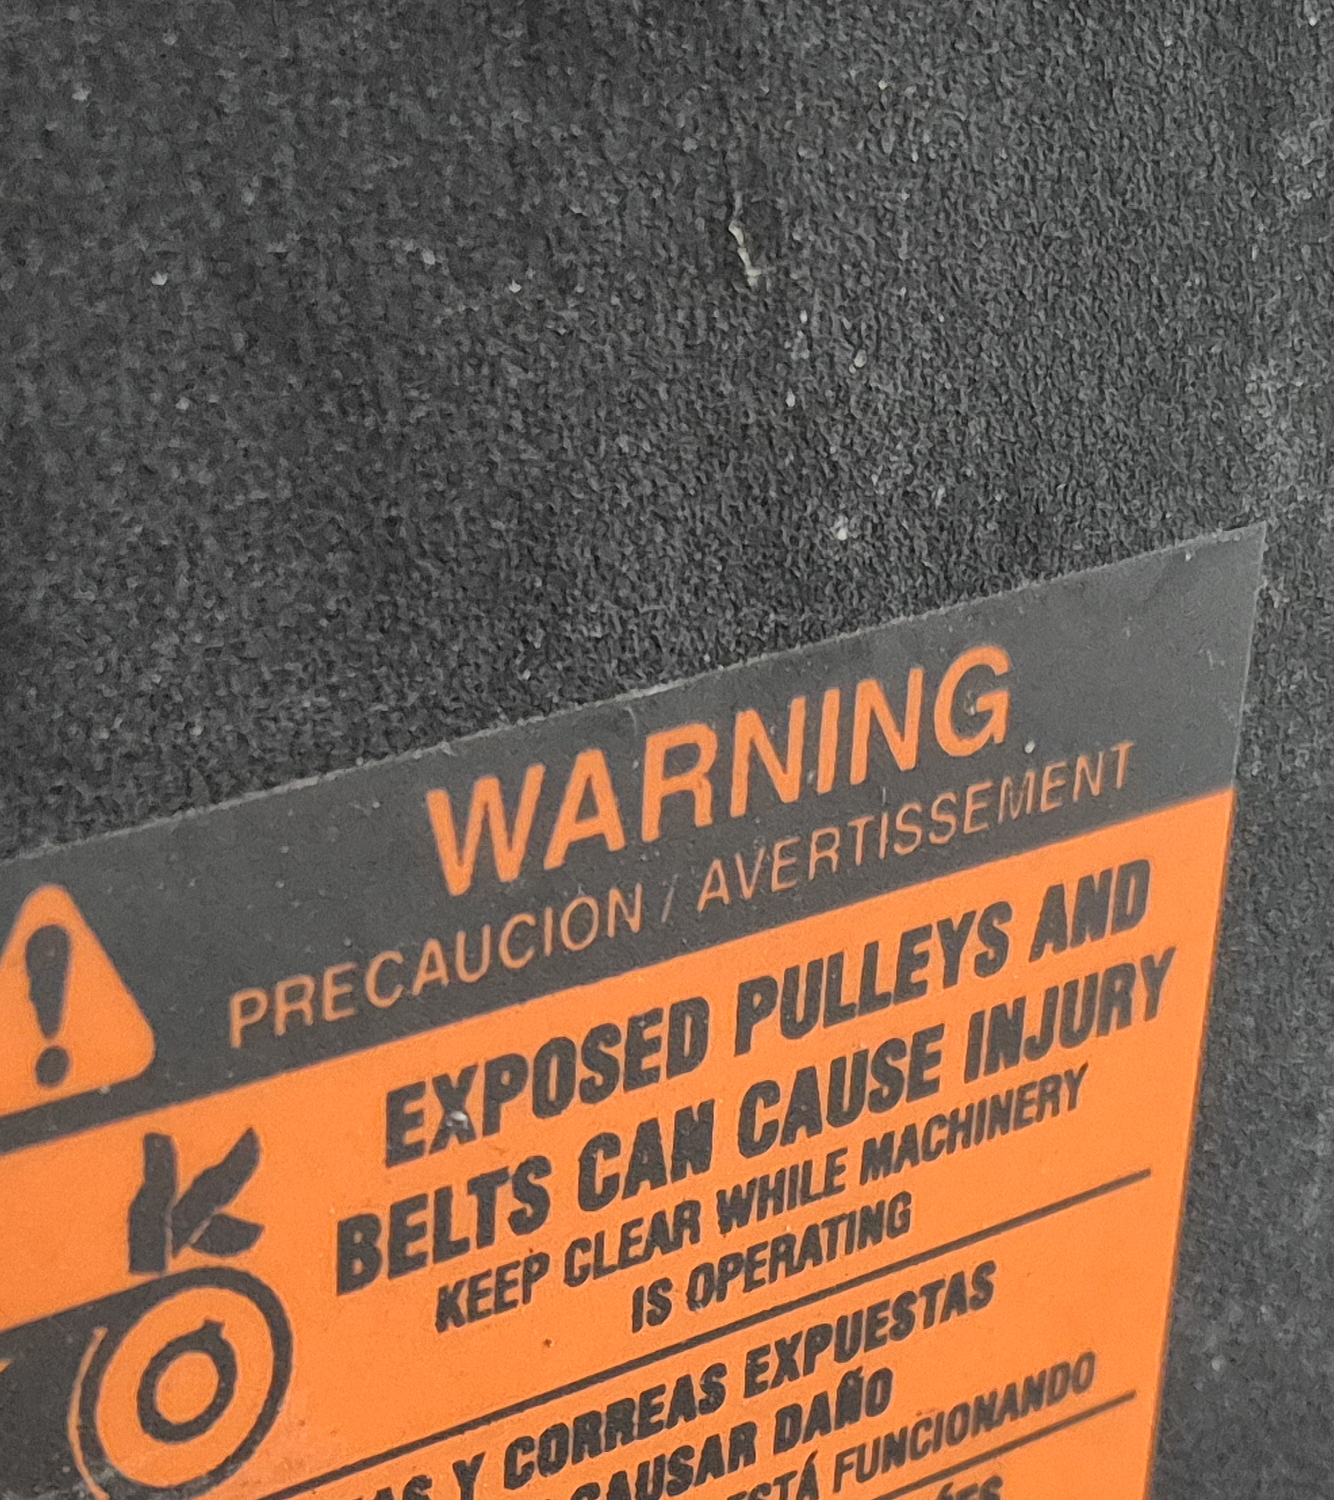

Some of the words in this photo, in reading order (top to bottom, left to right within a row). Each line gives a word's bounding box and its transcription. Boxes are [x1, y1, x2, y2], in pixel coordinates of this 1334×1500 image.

[428, 646, 1010, 896] WARNING
[697, 741, 1132, 911] AVERTISSEMENT
[338, 1156, 553, 1295] BELTS
[581, 1100, 715, 1212] CAN
[738, 1025, 945, 1159] CAUSE
[966, 948, 1176, 1082] INJURY
[387, 997, 710, 1167] EXPOSED
[735, 901, 1014, 1056] PULLEYS
[1031, 859, 1152, 960] AND
[436, 1252, 551, 1333] KEEP
[564, 1200, 702, 1288] CLEAR
[717, 1148, 848, 1234] WHILE
[860, 1068, 1086, 1184] MACHINERY
[632, 1278, 673, 1333] IS
[687, 1191, 912, 1312] OPERATING
[504, 1363, 728, 1491] CORREAS
[745, 1262, 997, 1399] EXPUESTAS
[773, 1368, 894, 1455] DAÑO
[834, 1352, 1097, 1493] FUNCIONANDO
